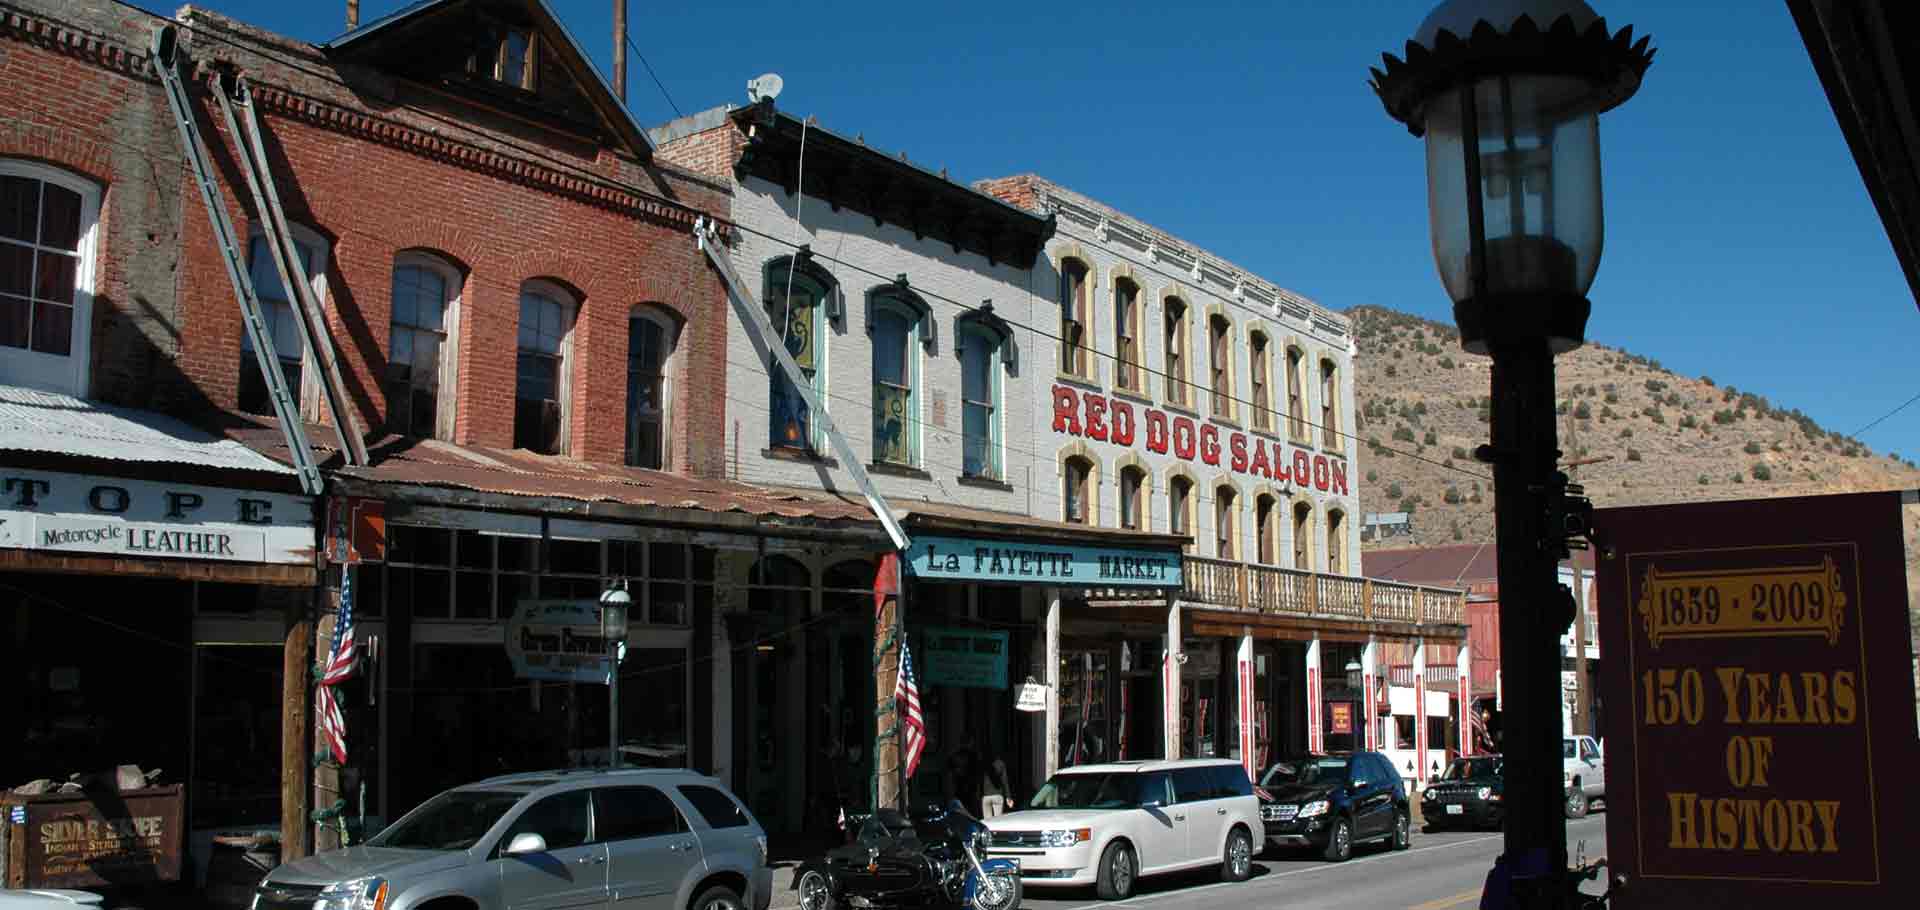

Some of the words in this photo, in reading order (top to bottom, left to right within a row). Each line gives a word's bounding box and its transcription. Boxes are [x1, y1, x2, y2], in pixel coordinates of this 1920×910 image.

[1052, 384, 1136, 447] RED
[1145, 408, 1221, 468] DOG
[1230, 432, 1348, 496] SALOON
[44, 523, 121, 546] Motorcycle
[127, 528, 234, 556] LEATHER
[927, 544, 960, 571] La
[974, 547, 1074, 577] FAYETTE
[1098, 555, 1169, 579] MARKET
[1659, 586, 1721, 627] 1859
[1750, 581, 1825, 623] 2009
[1642, 666, 1705, 727] 150
[1714, 666, 1857, 726] YEARS
[1726, 735, 1774, 788] OF
[105, 815, 163, 839] SPE
[1666, 791, 1841, 853] HISTORY
